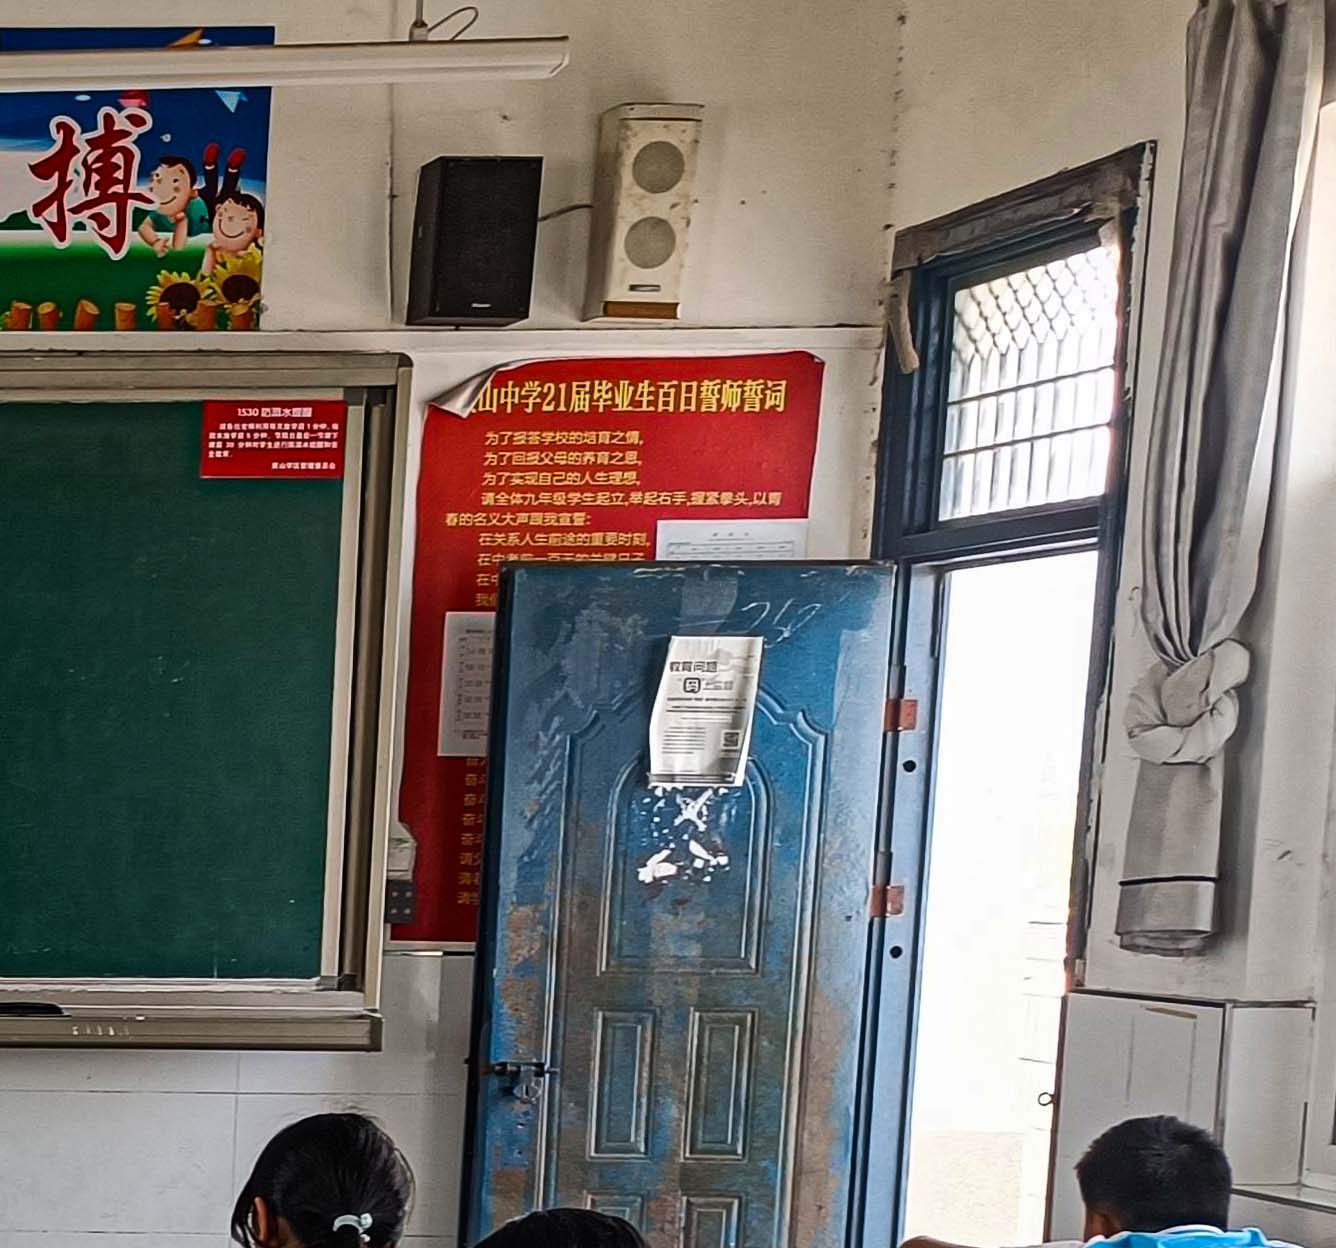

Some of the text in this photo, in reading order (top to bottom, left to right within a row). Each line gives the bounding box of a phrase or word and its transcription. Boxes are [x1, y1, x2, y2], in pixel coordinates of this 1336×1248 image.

[471, 378, 787, 414] 山中学21届毕业生百日誓师誓词
